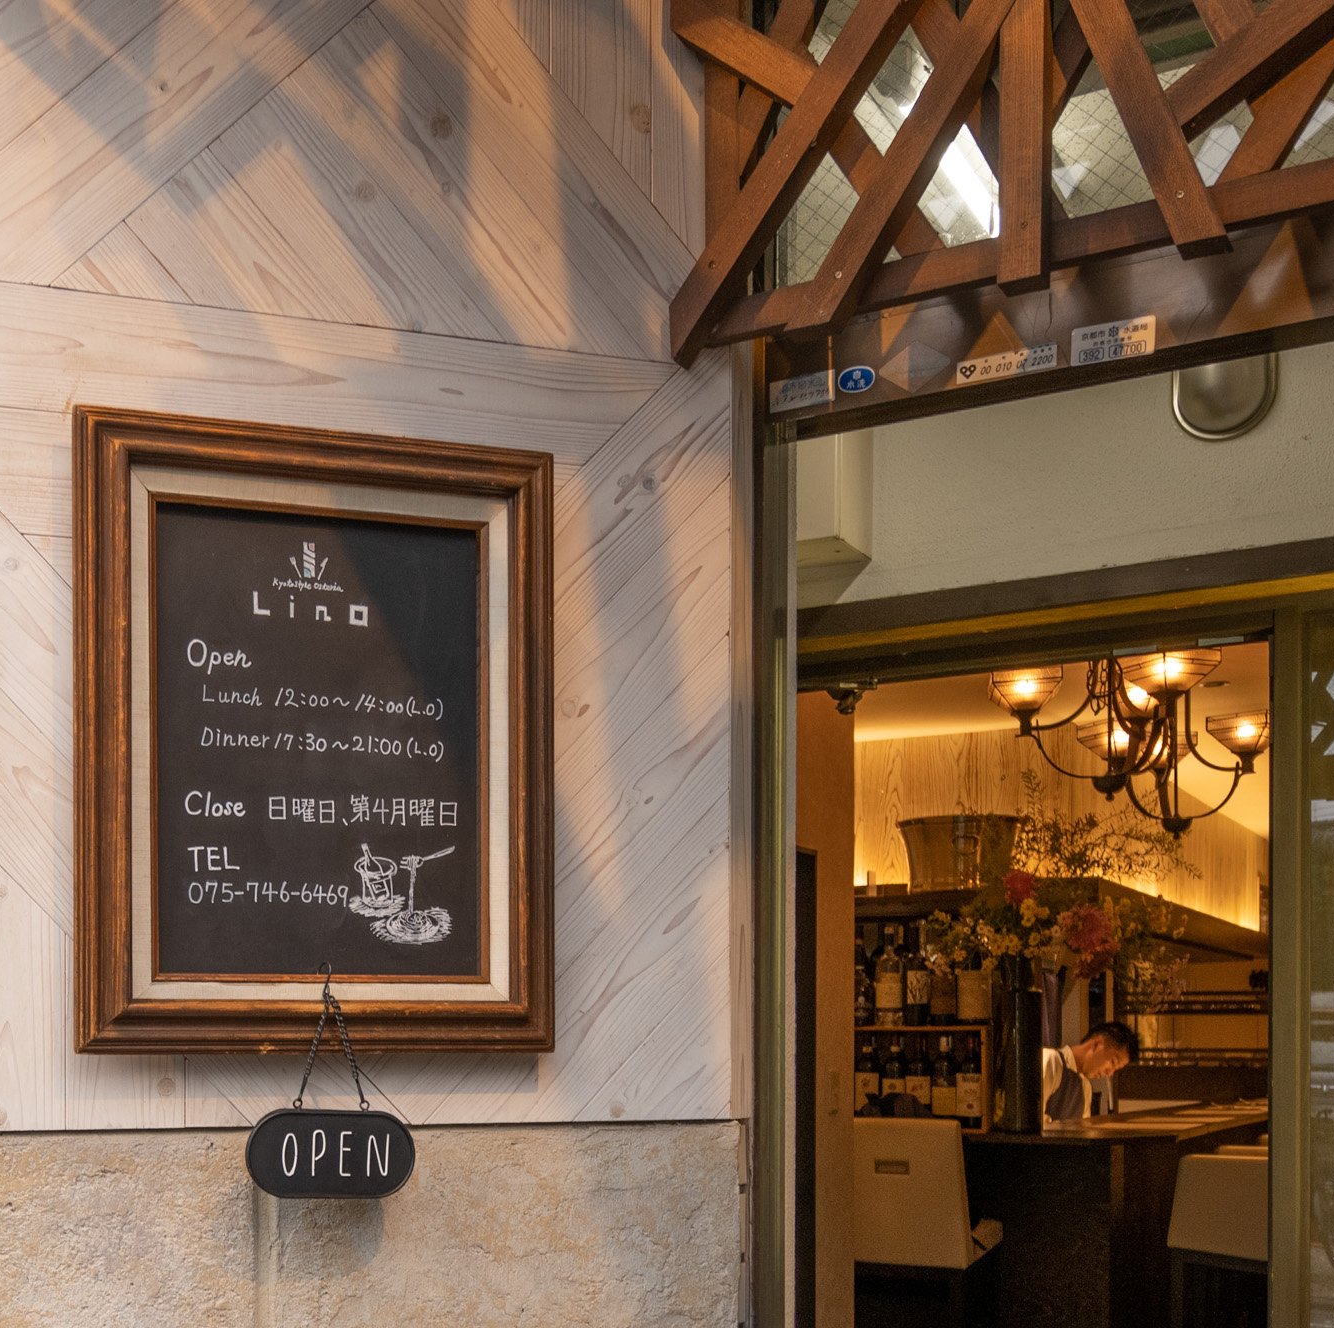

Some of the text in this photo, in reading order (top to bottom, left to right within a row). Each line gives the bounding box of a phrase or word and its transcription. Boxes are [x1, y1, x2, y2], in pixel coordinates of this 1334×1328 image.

[980, 365, 992, 375] 00
[995, 361, 1013, 373] 010
[1031, 354, 1054, 367] 2200
[1082, 343, 1143, 361] 392 47700
[252, 591, 369, 628] Lino
[186, 638, 252, 675] Open
[202, 684, 263, 707] Lunch
[200, 727, 270, 748] Dinner
[184, 790, 246, 817] Close
[187, 846, 240, 872] TEL
[187, 881, 349, 907] 075-746-6469
[280, 1128, 391, 1177] OPEN
